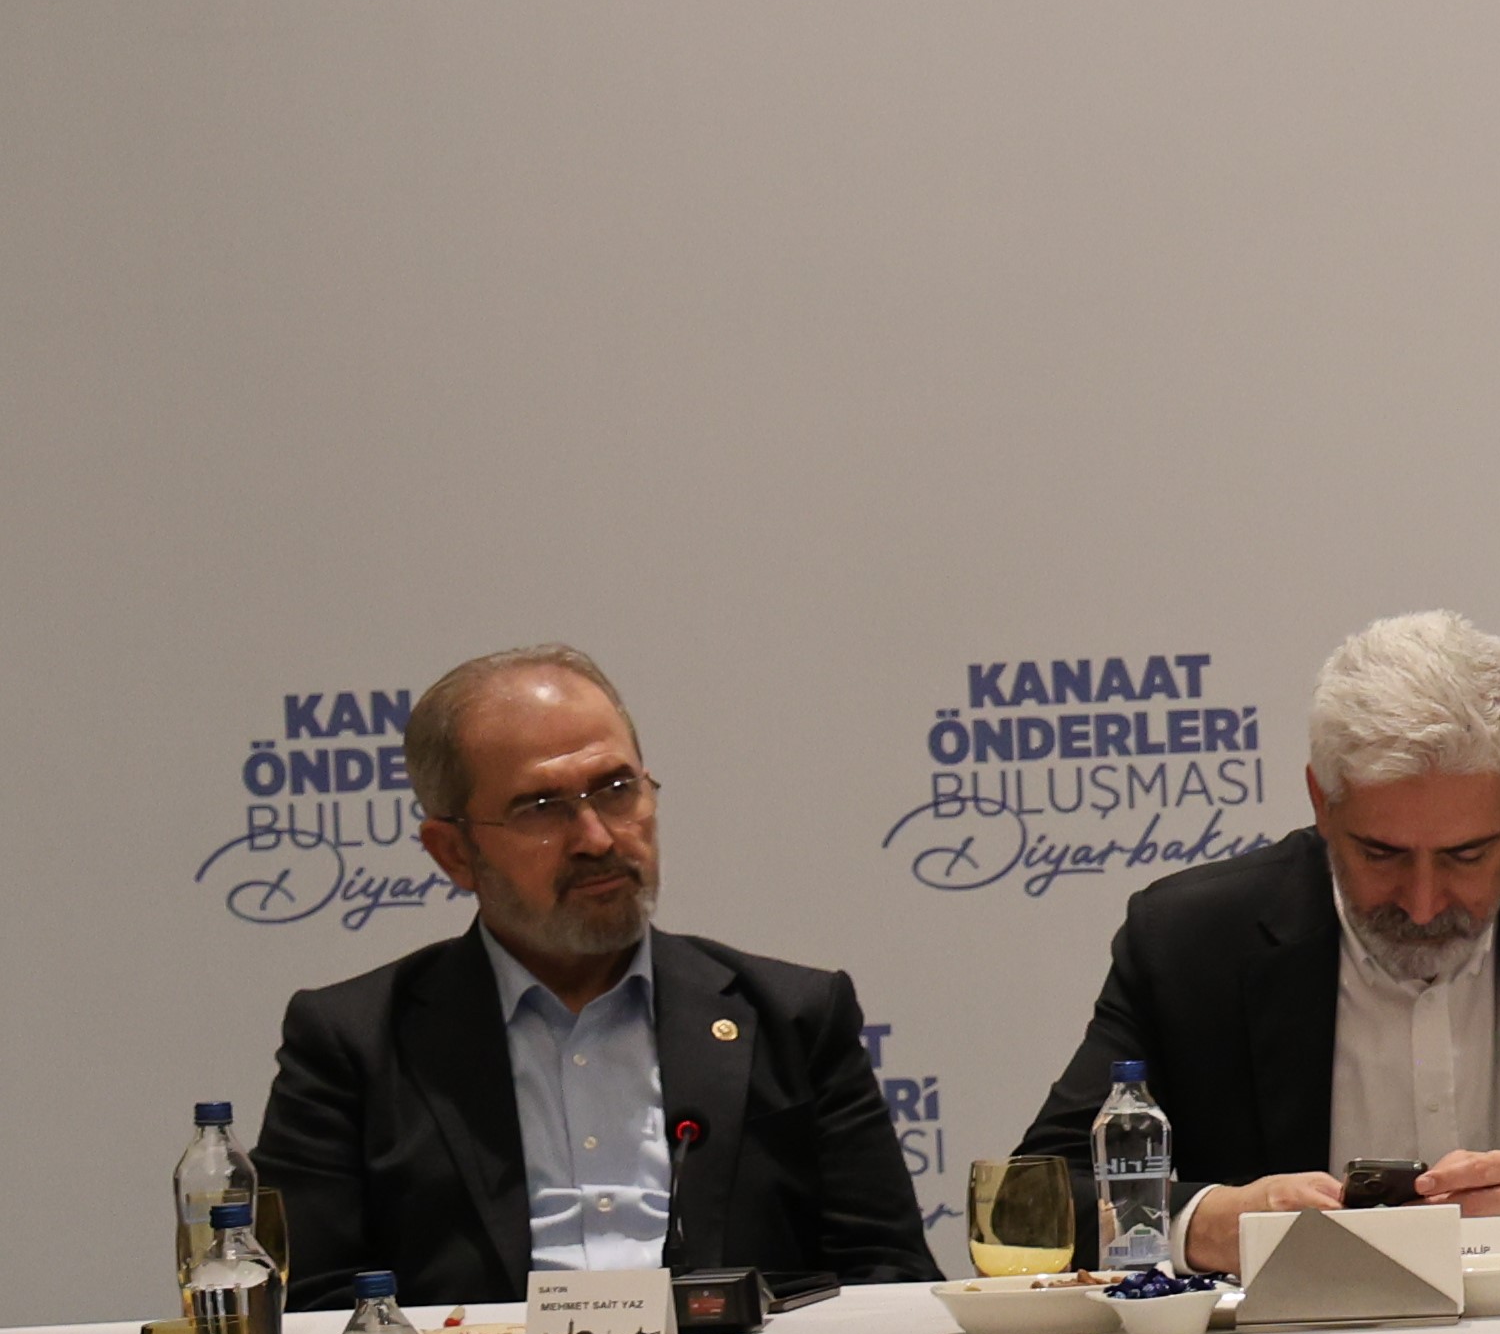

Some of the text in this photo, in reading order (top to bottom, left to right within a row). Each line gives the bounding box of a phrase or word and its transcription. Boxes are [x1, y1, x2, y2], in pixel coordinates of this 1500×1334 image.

[967, 653, 1211, 709] KANAAT
[284, 689, 411, 740] KAN
[928, 707, 1258, 765] ÖNDERLERİ
[932, 758, 1264, 818] BULUŞMASI
[195, 829, 478, 931] Diyar
[541, 1301, 590, 1312] MEHMET
[622, 1299, 644, 1310] YAZ
